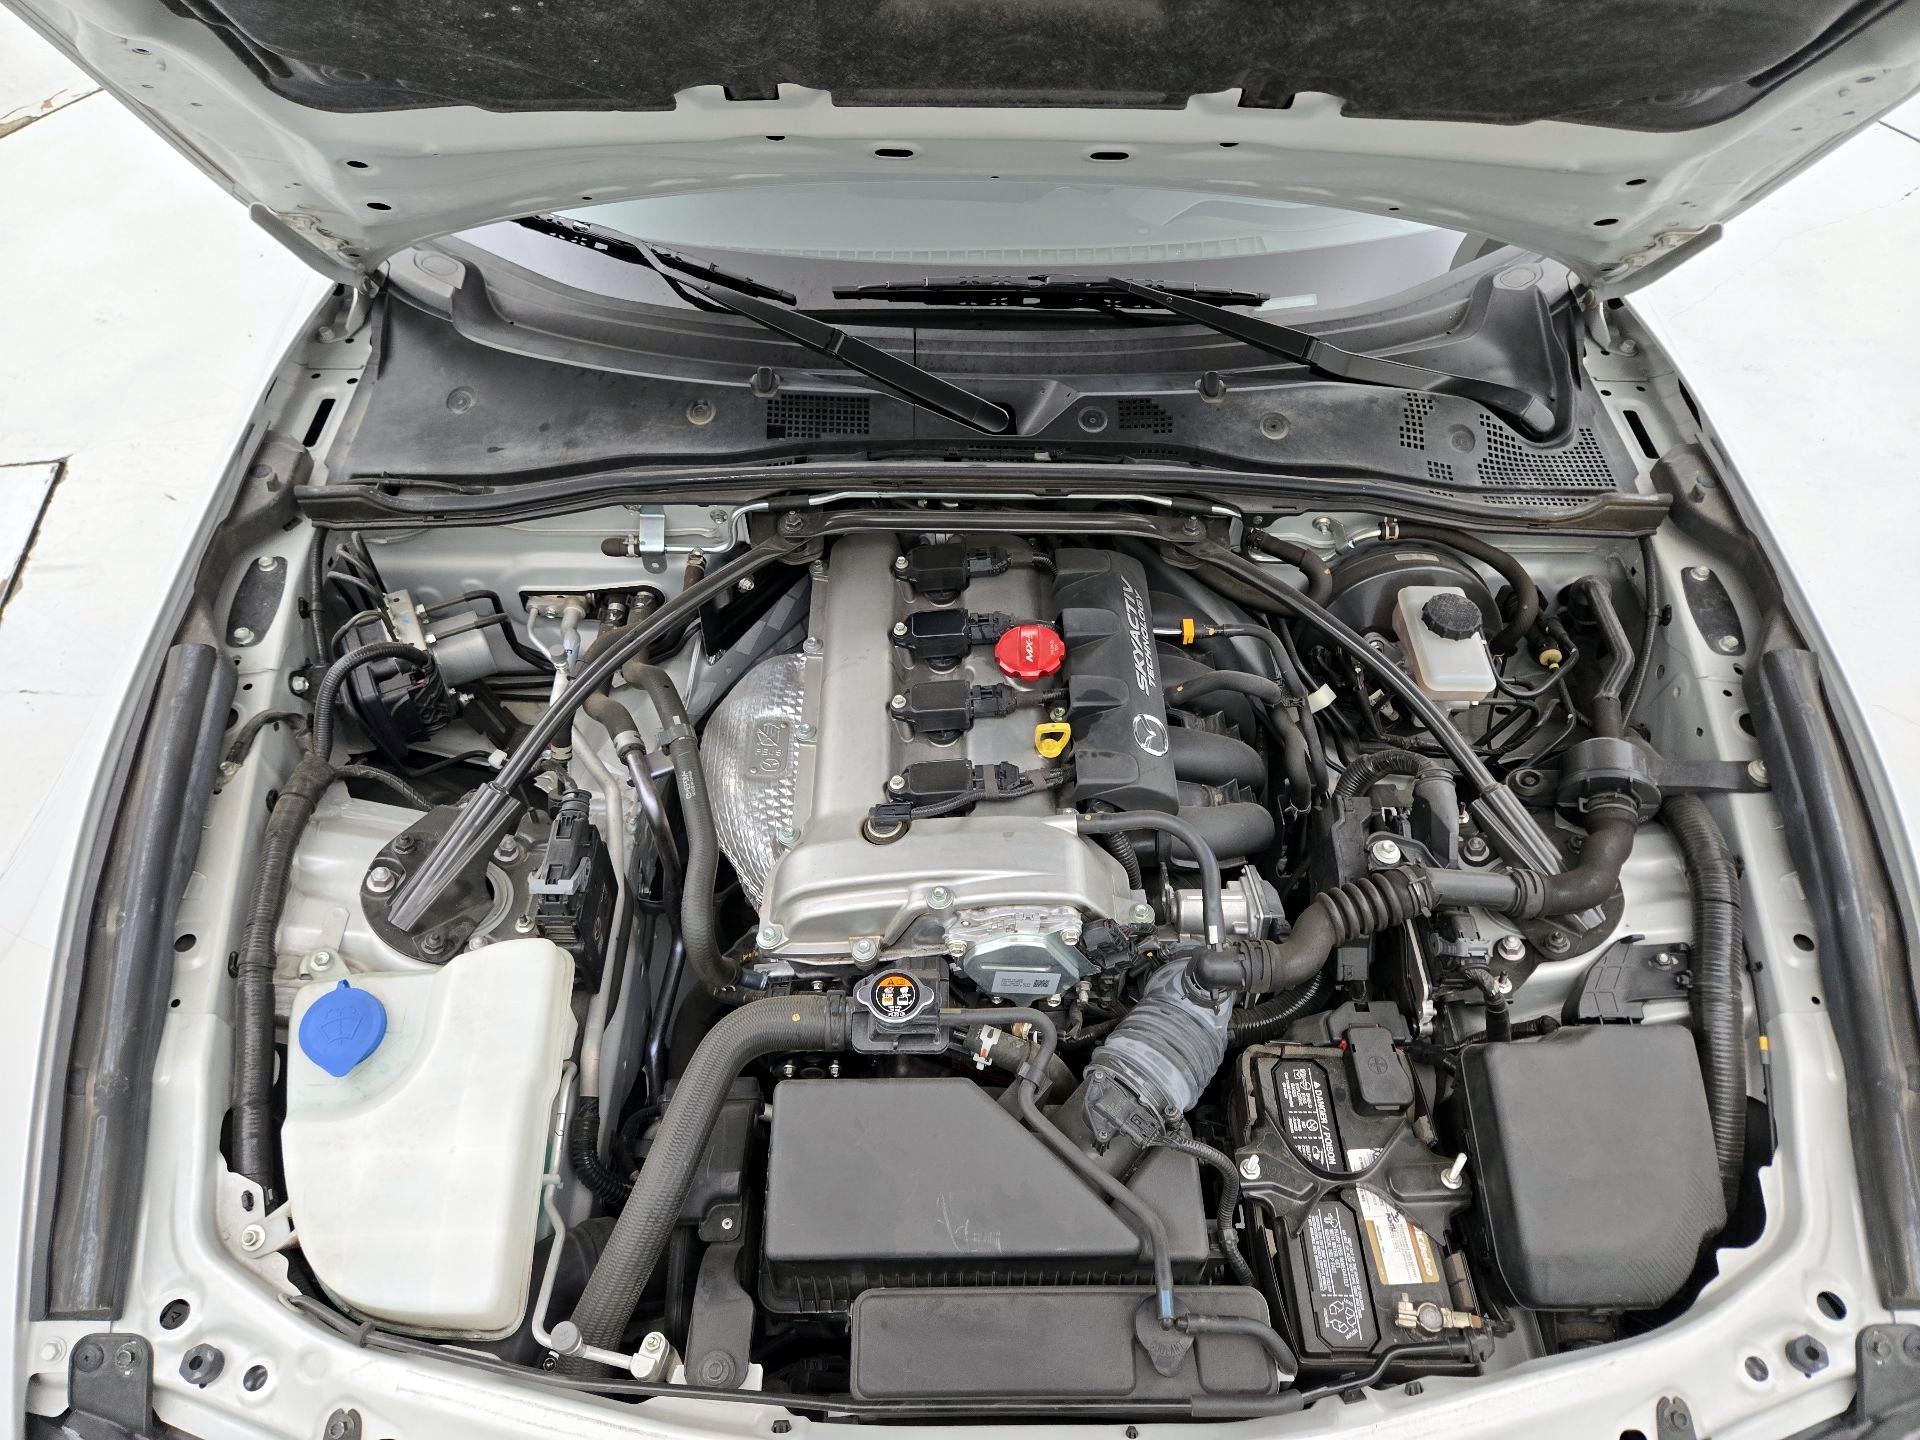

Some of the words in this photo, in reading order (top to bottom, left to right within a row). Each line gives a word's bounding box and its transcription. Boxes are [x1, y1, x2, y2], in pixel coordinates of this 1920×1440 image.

[1024, 630, 1033, 662] MX-5
[1120, 575, 1150, 697] SKYACTIV
[1135, 588, 1157, 687] TECHNOLOGY
[1314, 1089, 1328, 1123] DANGER
[1323, 1132, 1337, 1165] POISON
[1414, 1228, 1434, 1276] ACDelco
